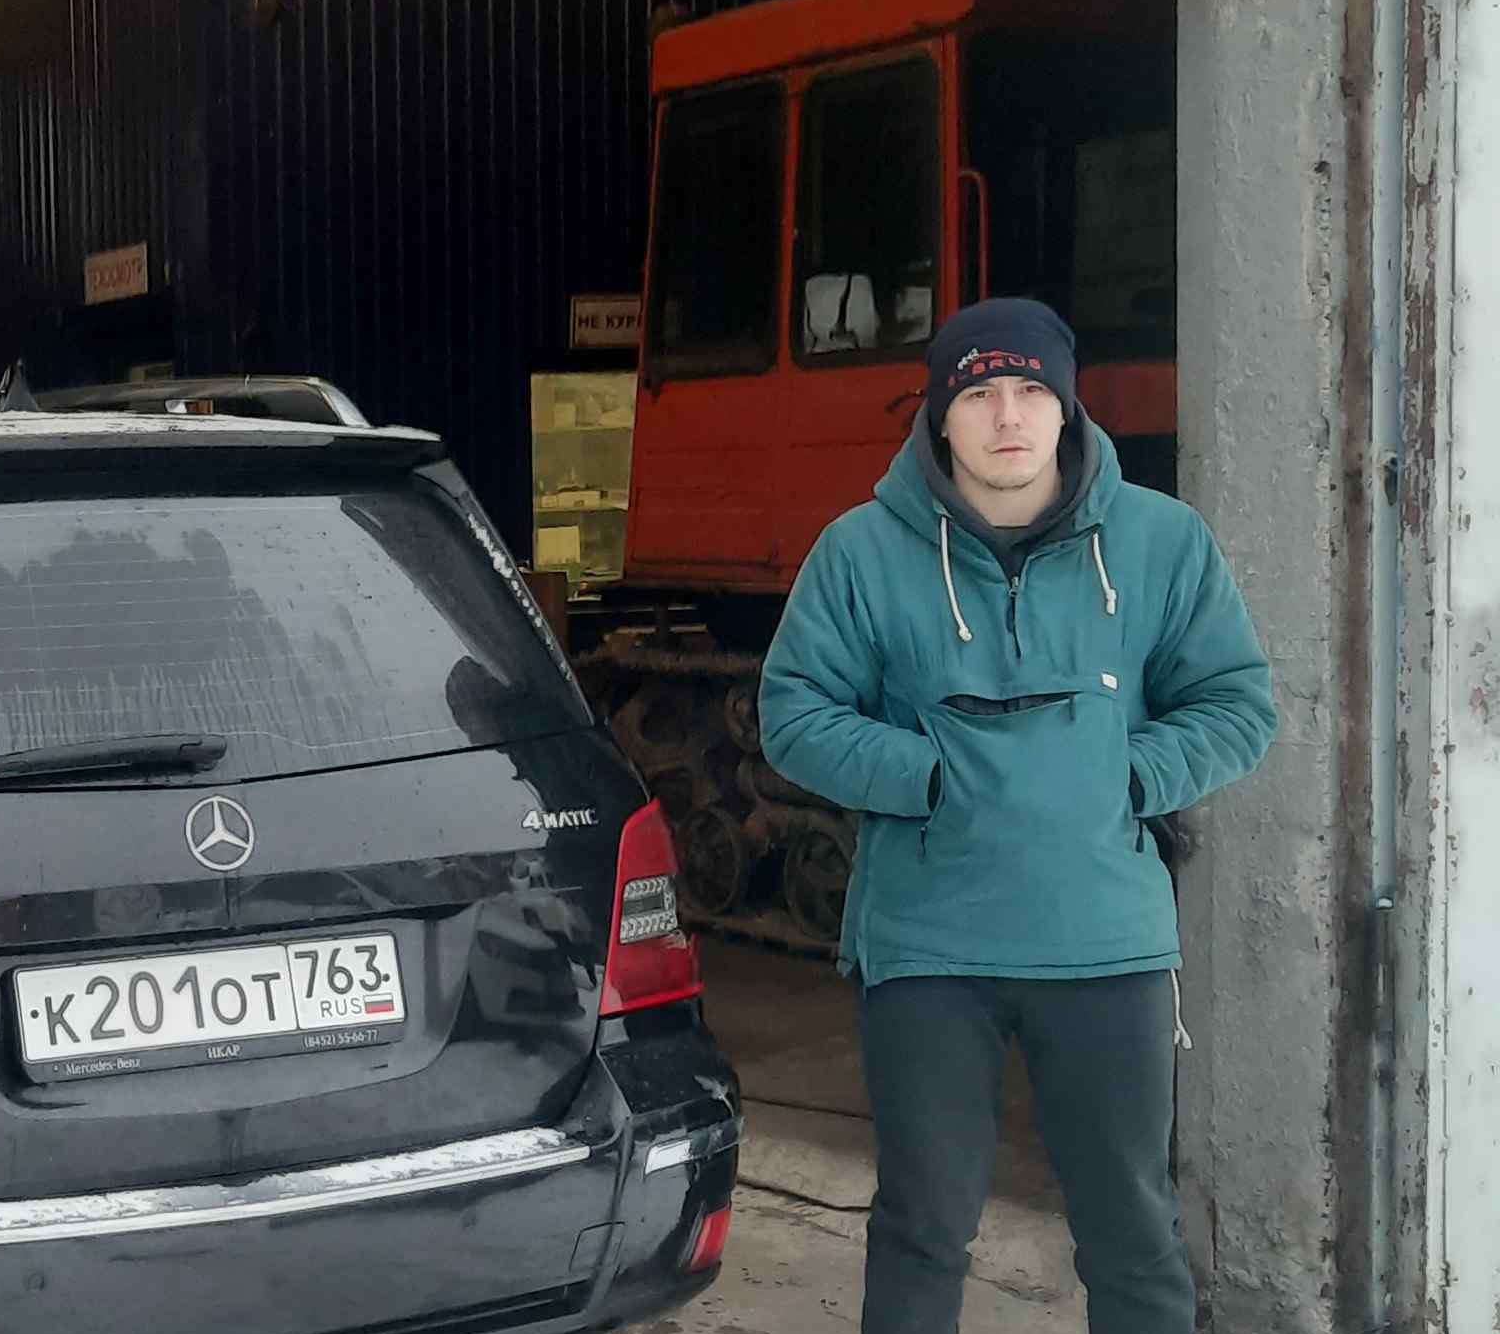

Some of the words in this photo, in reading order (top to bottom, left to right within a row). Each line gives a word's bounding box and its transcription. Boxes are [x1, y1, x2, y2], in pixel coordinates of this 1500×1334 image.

[578, 314, 599, 329] НЕ
[522, 809, 598, 829] 4MATIC
[44, 965, 281, 1046] К201ОТ
[294, 944, 382, 999] 763
[320, 999, 363, 1018] RUS
[65, 1057, 141, 1076] Mercedes-Benz
